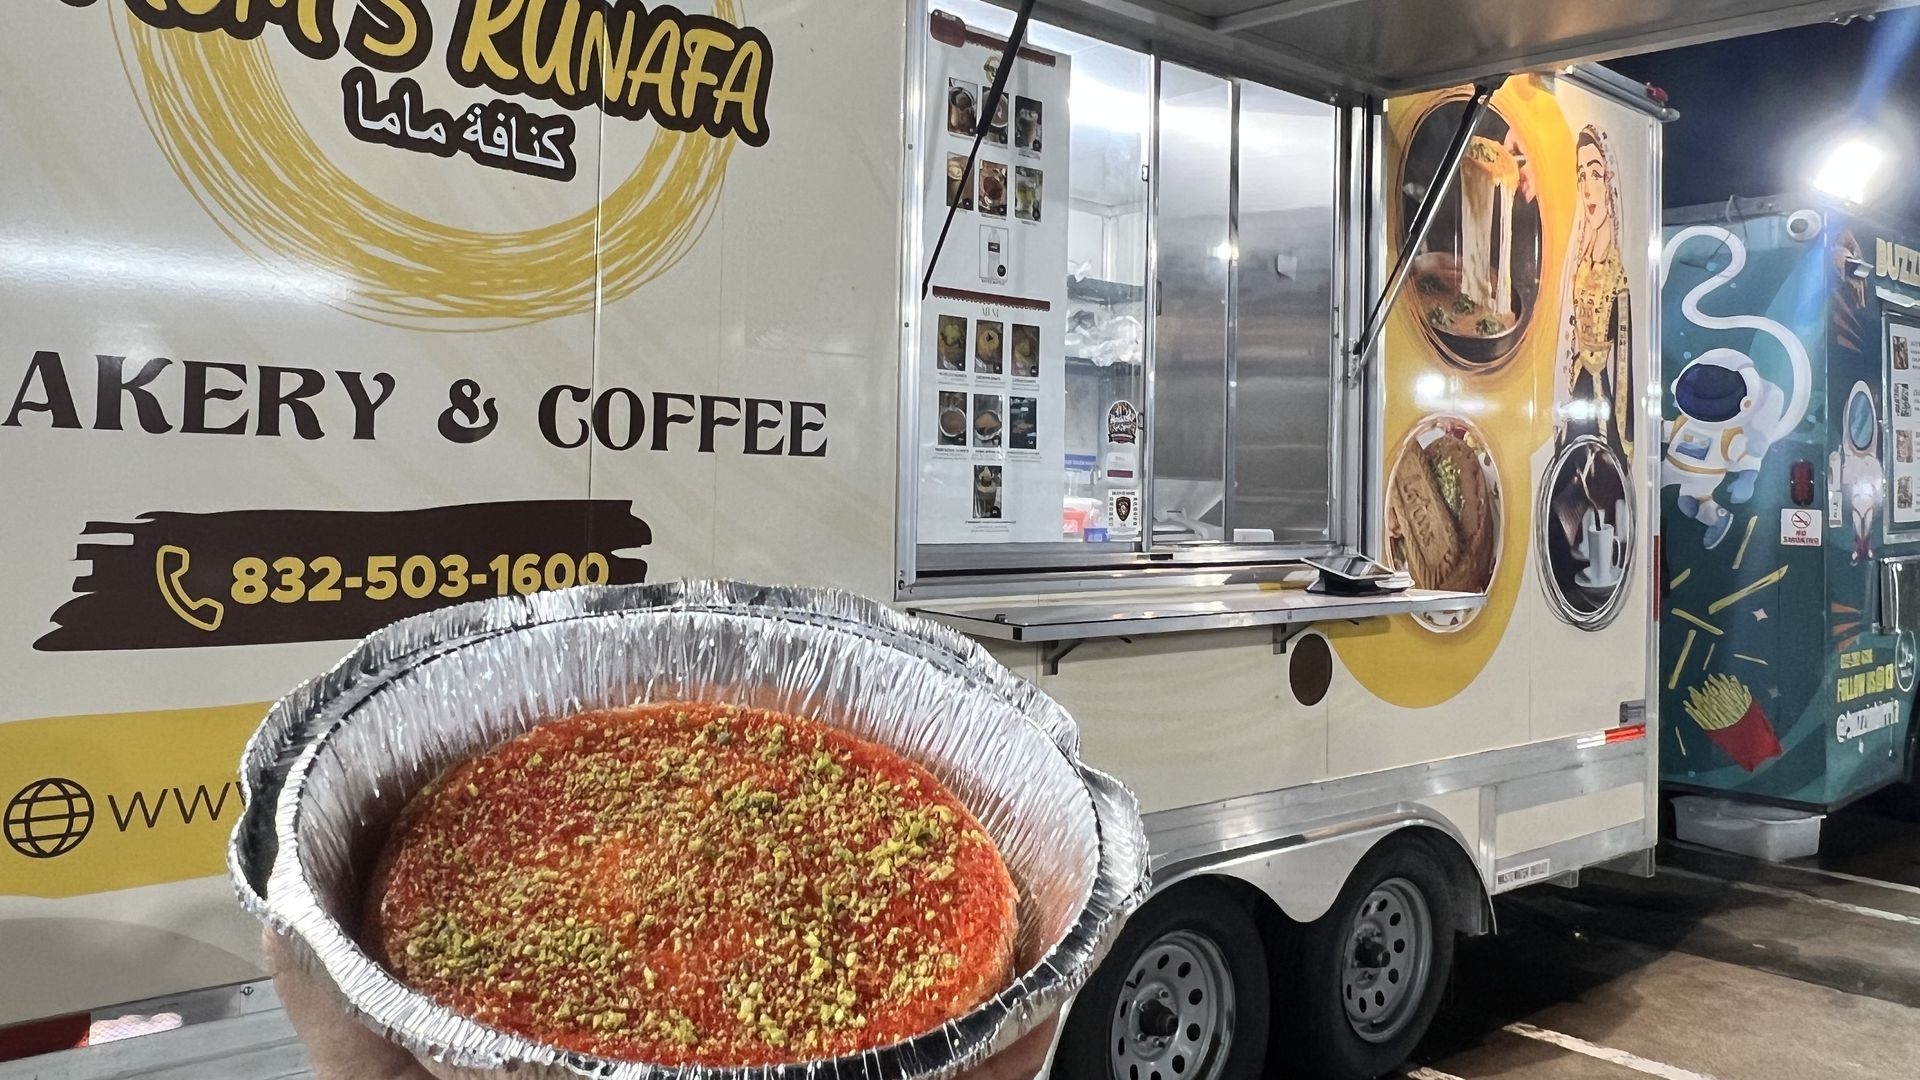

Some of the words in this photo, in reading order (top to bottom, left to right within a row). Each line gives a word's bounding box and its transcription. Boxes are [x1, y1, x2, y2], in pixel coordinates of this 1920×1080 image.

[355, 80, 448, 145] ماما
[462, 106, 566, 170] كنافة
[437, 378, 499, 444] &
[538, 384, 829, 458] COFFEE
[230, 551, 610, 605] 832-503-1600
